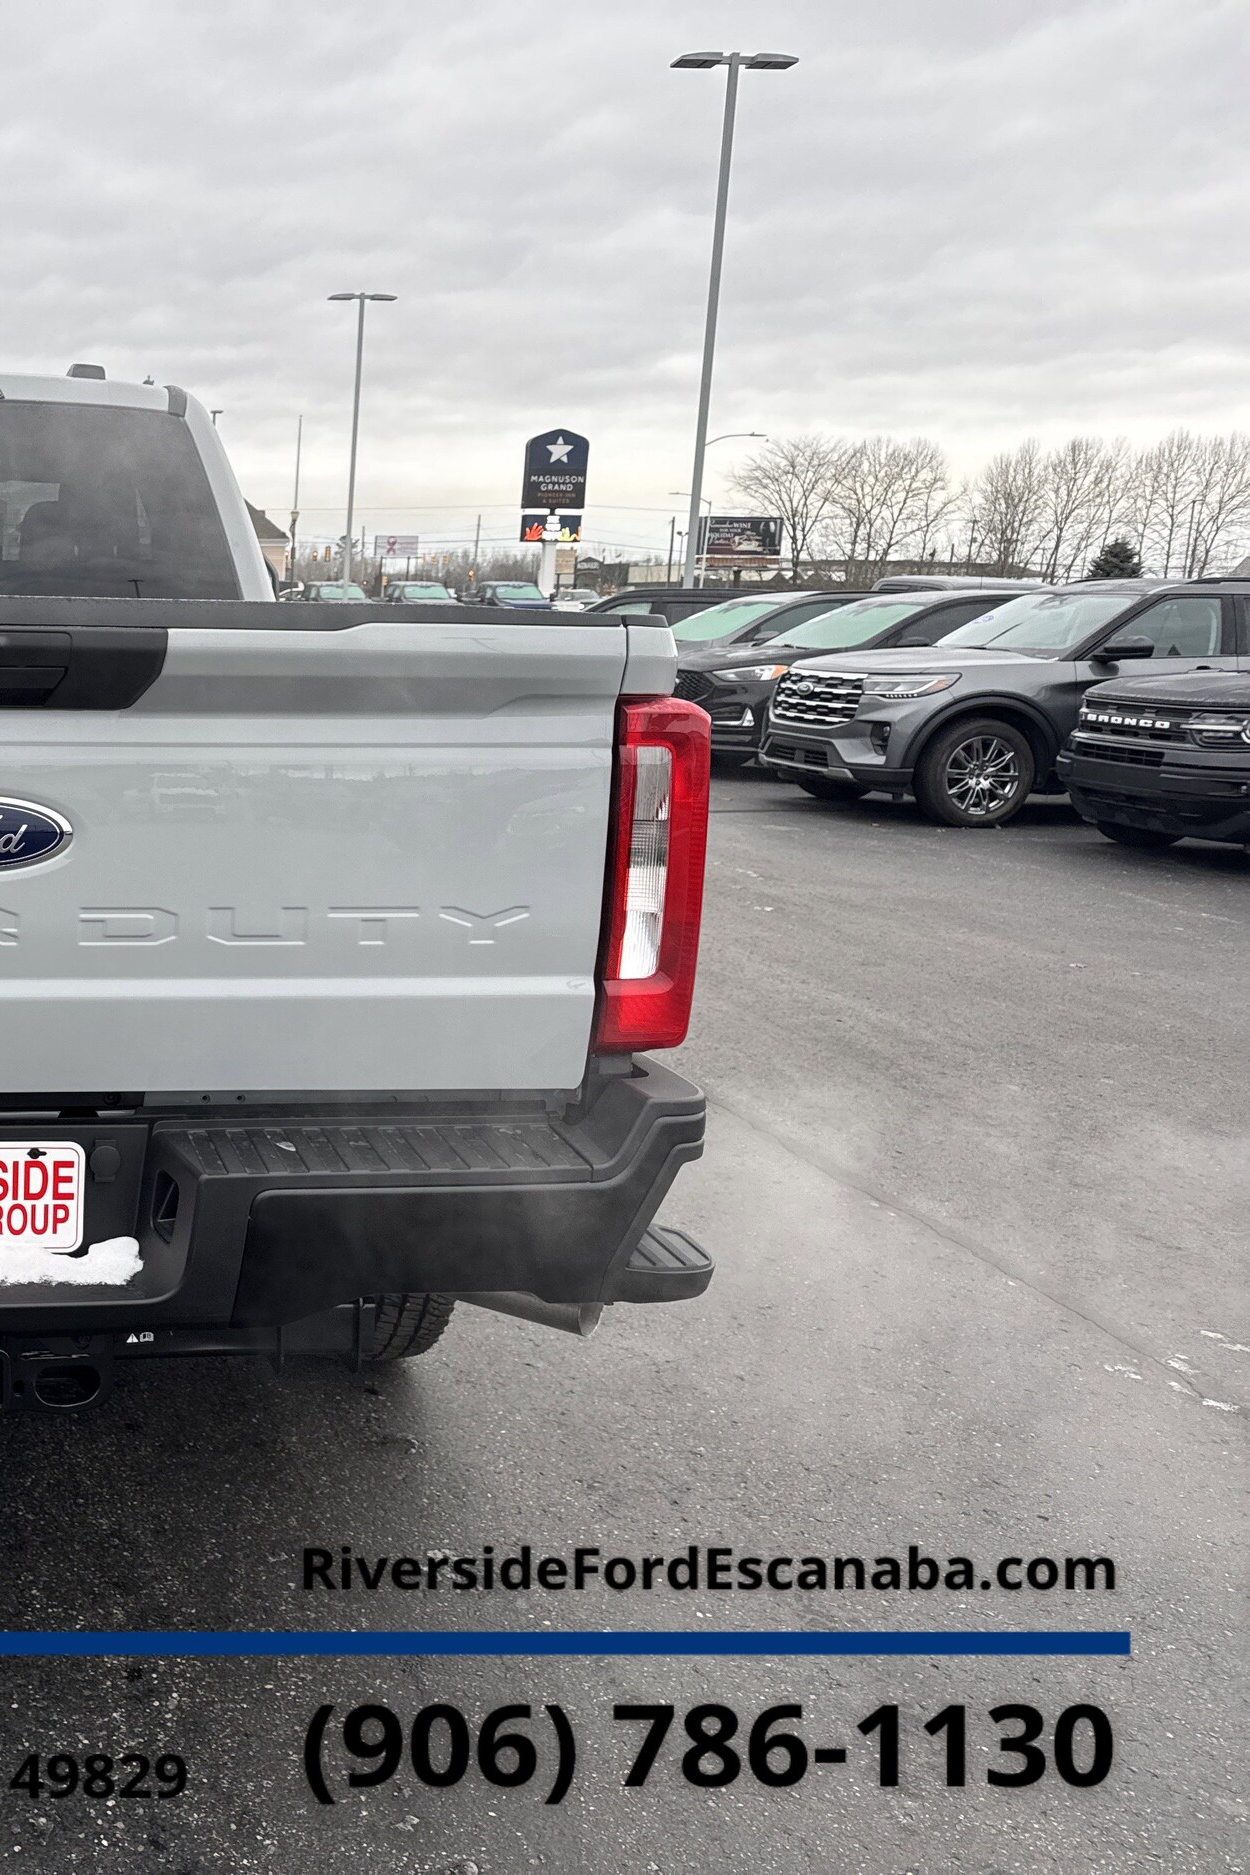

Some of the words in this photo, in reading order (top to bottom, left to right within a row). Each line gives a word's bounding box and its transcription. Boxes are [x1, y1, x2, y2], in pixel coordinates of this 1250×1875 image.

[530, 475, 585, 483] MAGNUSON
[540, 483, 574, 491] GRAND
[1087, 713, 1170, 729] BRONCO
[78, 906, 530, 945] DUTY
